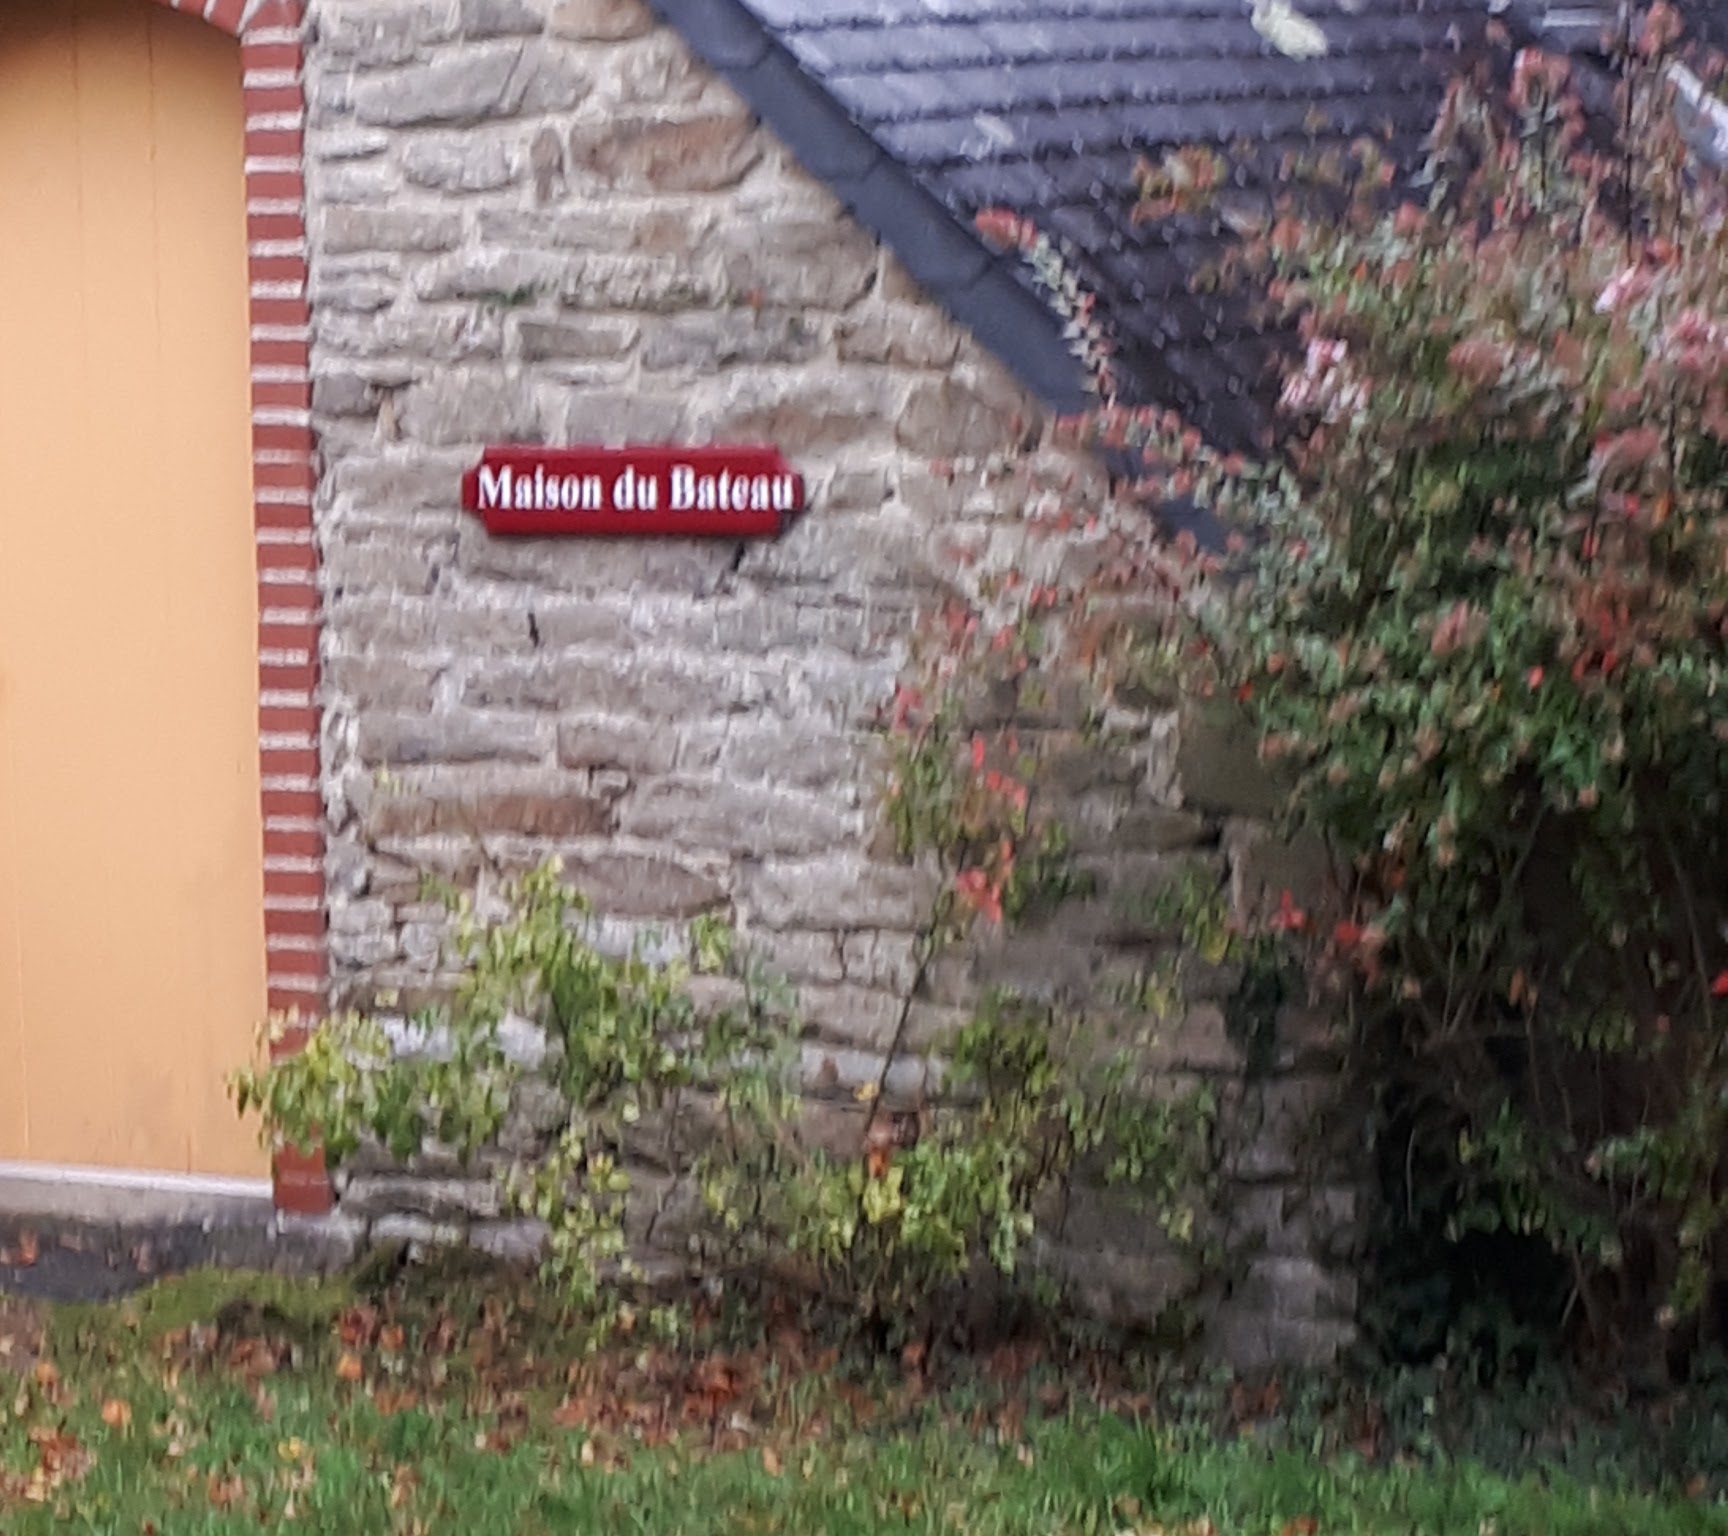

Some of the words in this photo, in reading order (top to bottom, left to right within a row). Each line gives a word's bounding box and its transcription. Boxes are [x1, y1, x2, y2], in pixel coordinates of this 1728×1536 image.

[477, 464, 602, 510] Maison
[613, 464, 658, 511] du
[670, 464, 794, 511] Bateau
